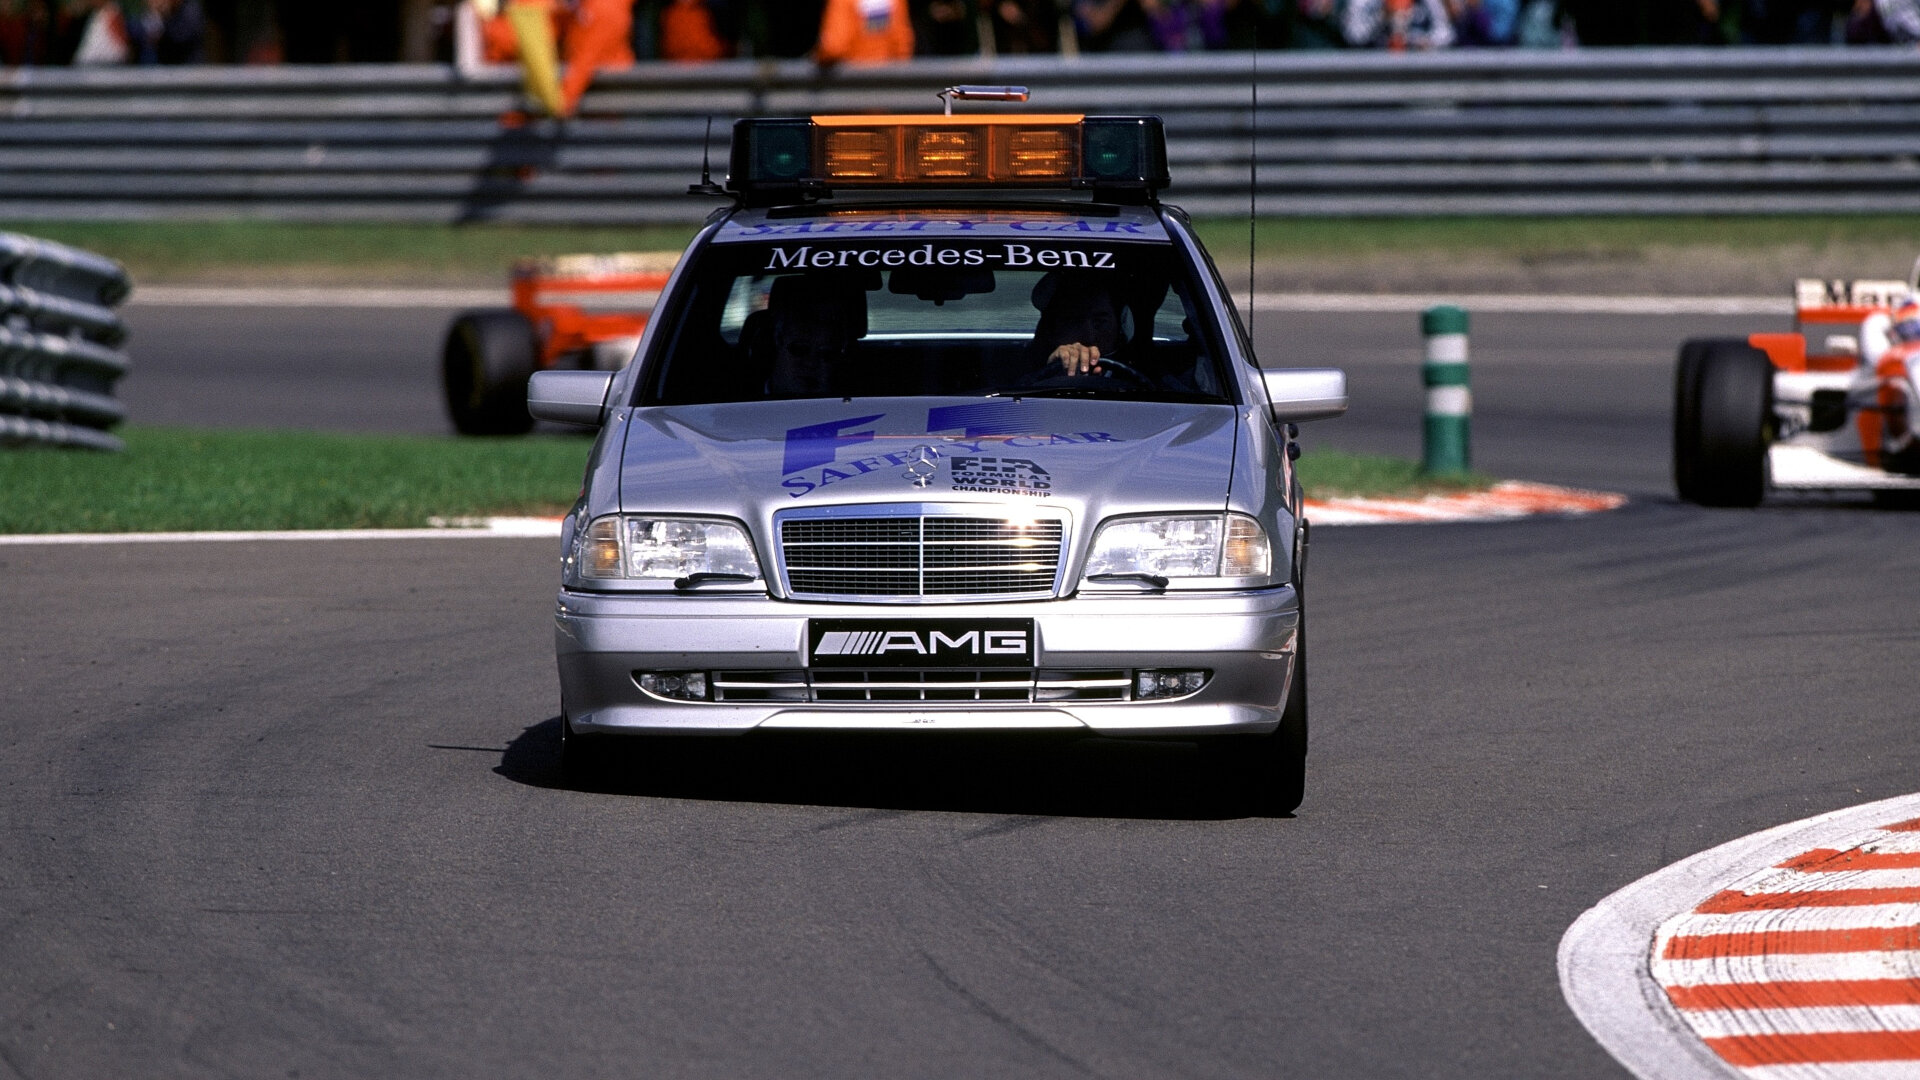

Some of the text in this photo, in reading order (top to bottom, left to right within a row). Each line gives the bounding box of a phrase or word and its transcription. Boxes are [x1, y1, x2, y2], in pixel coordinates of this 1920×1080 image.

[739, 220, 1146, 236] SAFETY CAR
[764, 244, 1116, 269] Mercedes-Benz
[781, 431, 1126, 498] SAFETY CAR
[951, 457, 1050, 475] FIA
[951, 471, 1040, 480] FORMULA
[952, 477, 1051, 489] WORLD
[951, 485, 1052, 498] CHAMPIONSHIP
[875, 630, 1028, 655] AMG
